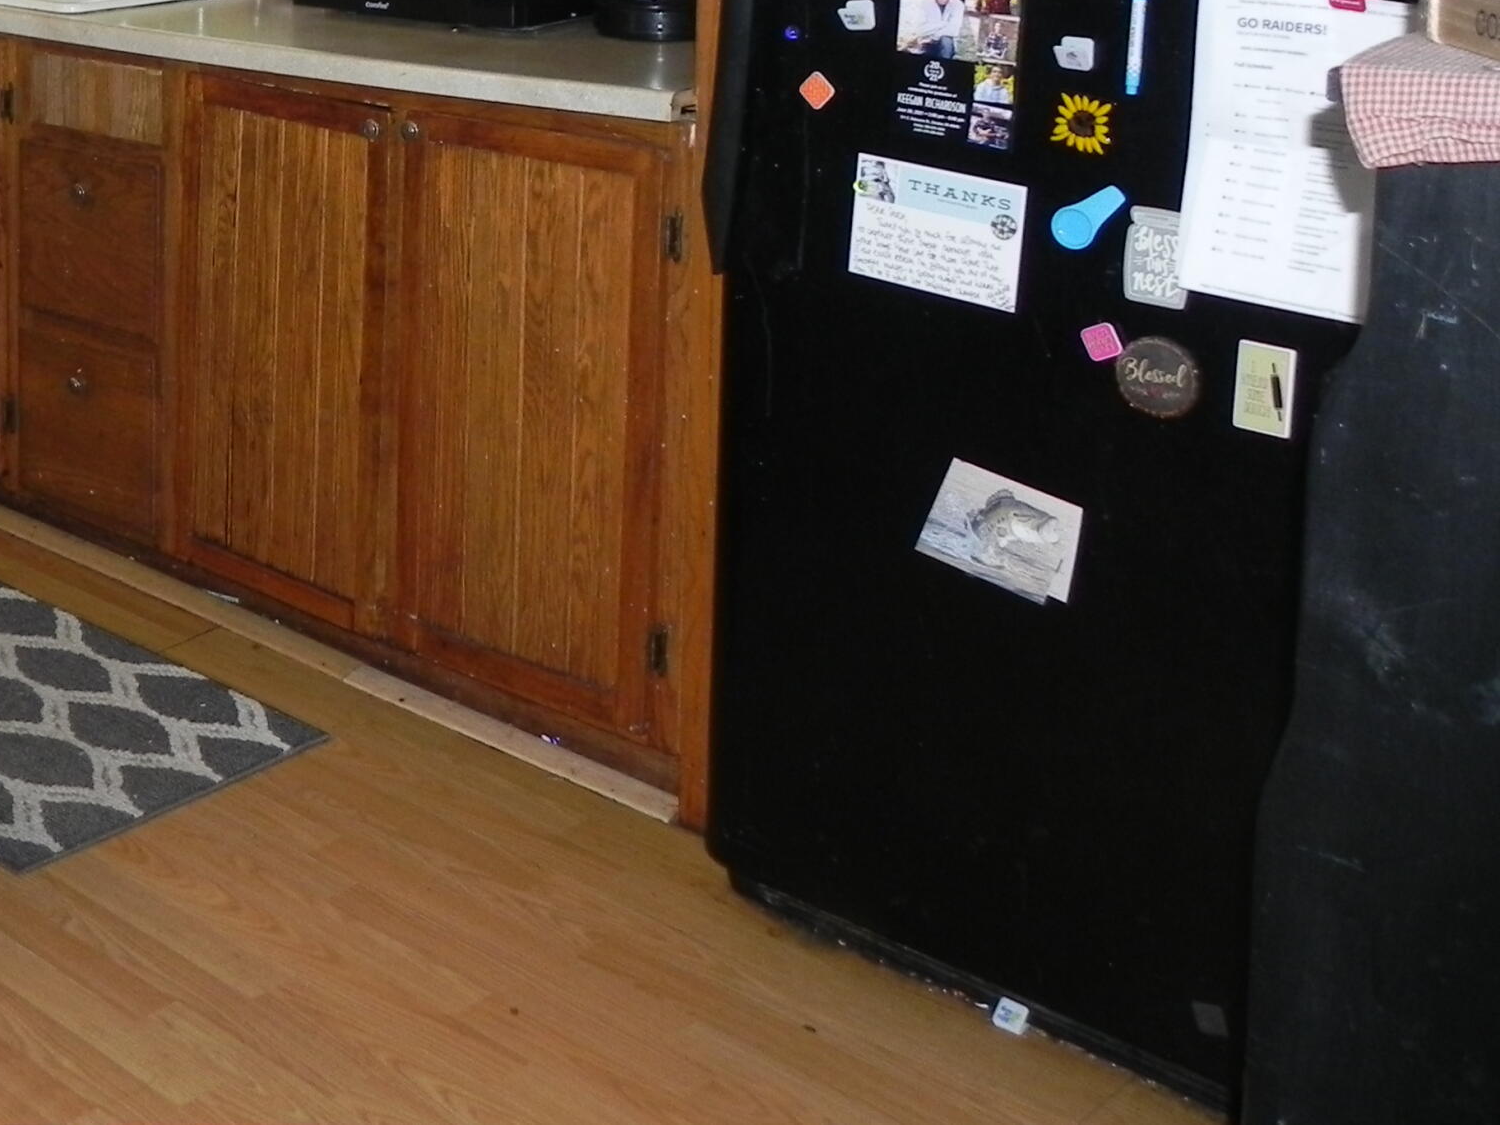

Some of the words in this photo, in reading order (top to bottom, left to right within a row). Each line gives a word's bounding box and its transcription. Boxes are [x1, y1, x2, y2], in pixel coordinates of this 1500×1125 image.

[1237, 17, 1259, 29] GO
[1262, 19, 1328, 35] RAIDERS!
[1475, 9, 1500, 40] CO
[897, 92, 924, 106] KEEGAN
[925, 96, 967, 114] RICHARDSON
[908, 179, 1011, 211] THANKS
[1123, 356, 1188, 388] Blessed
